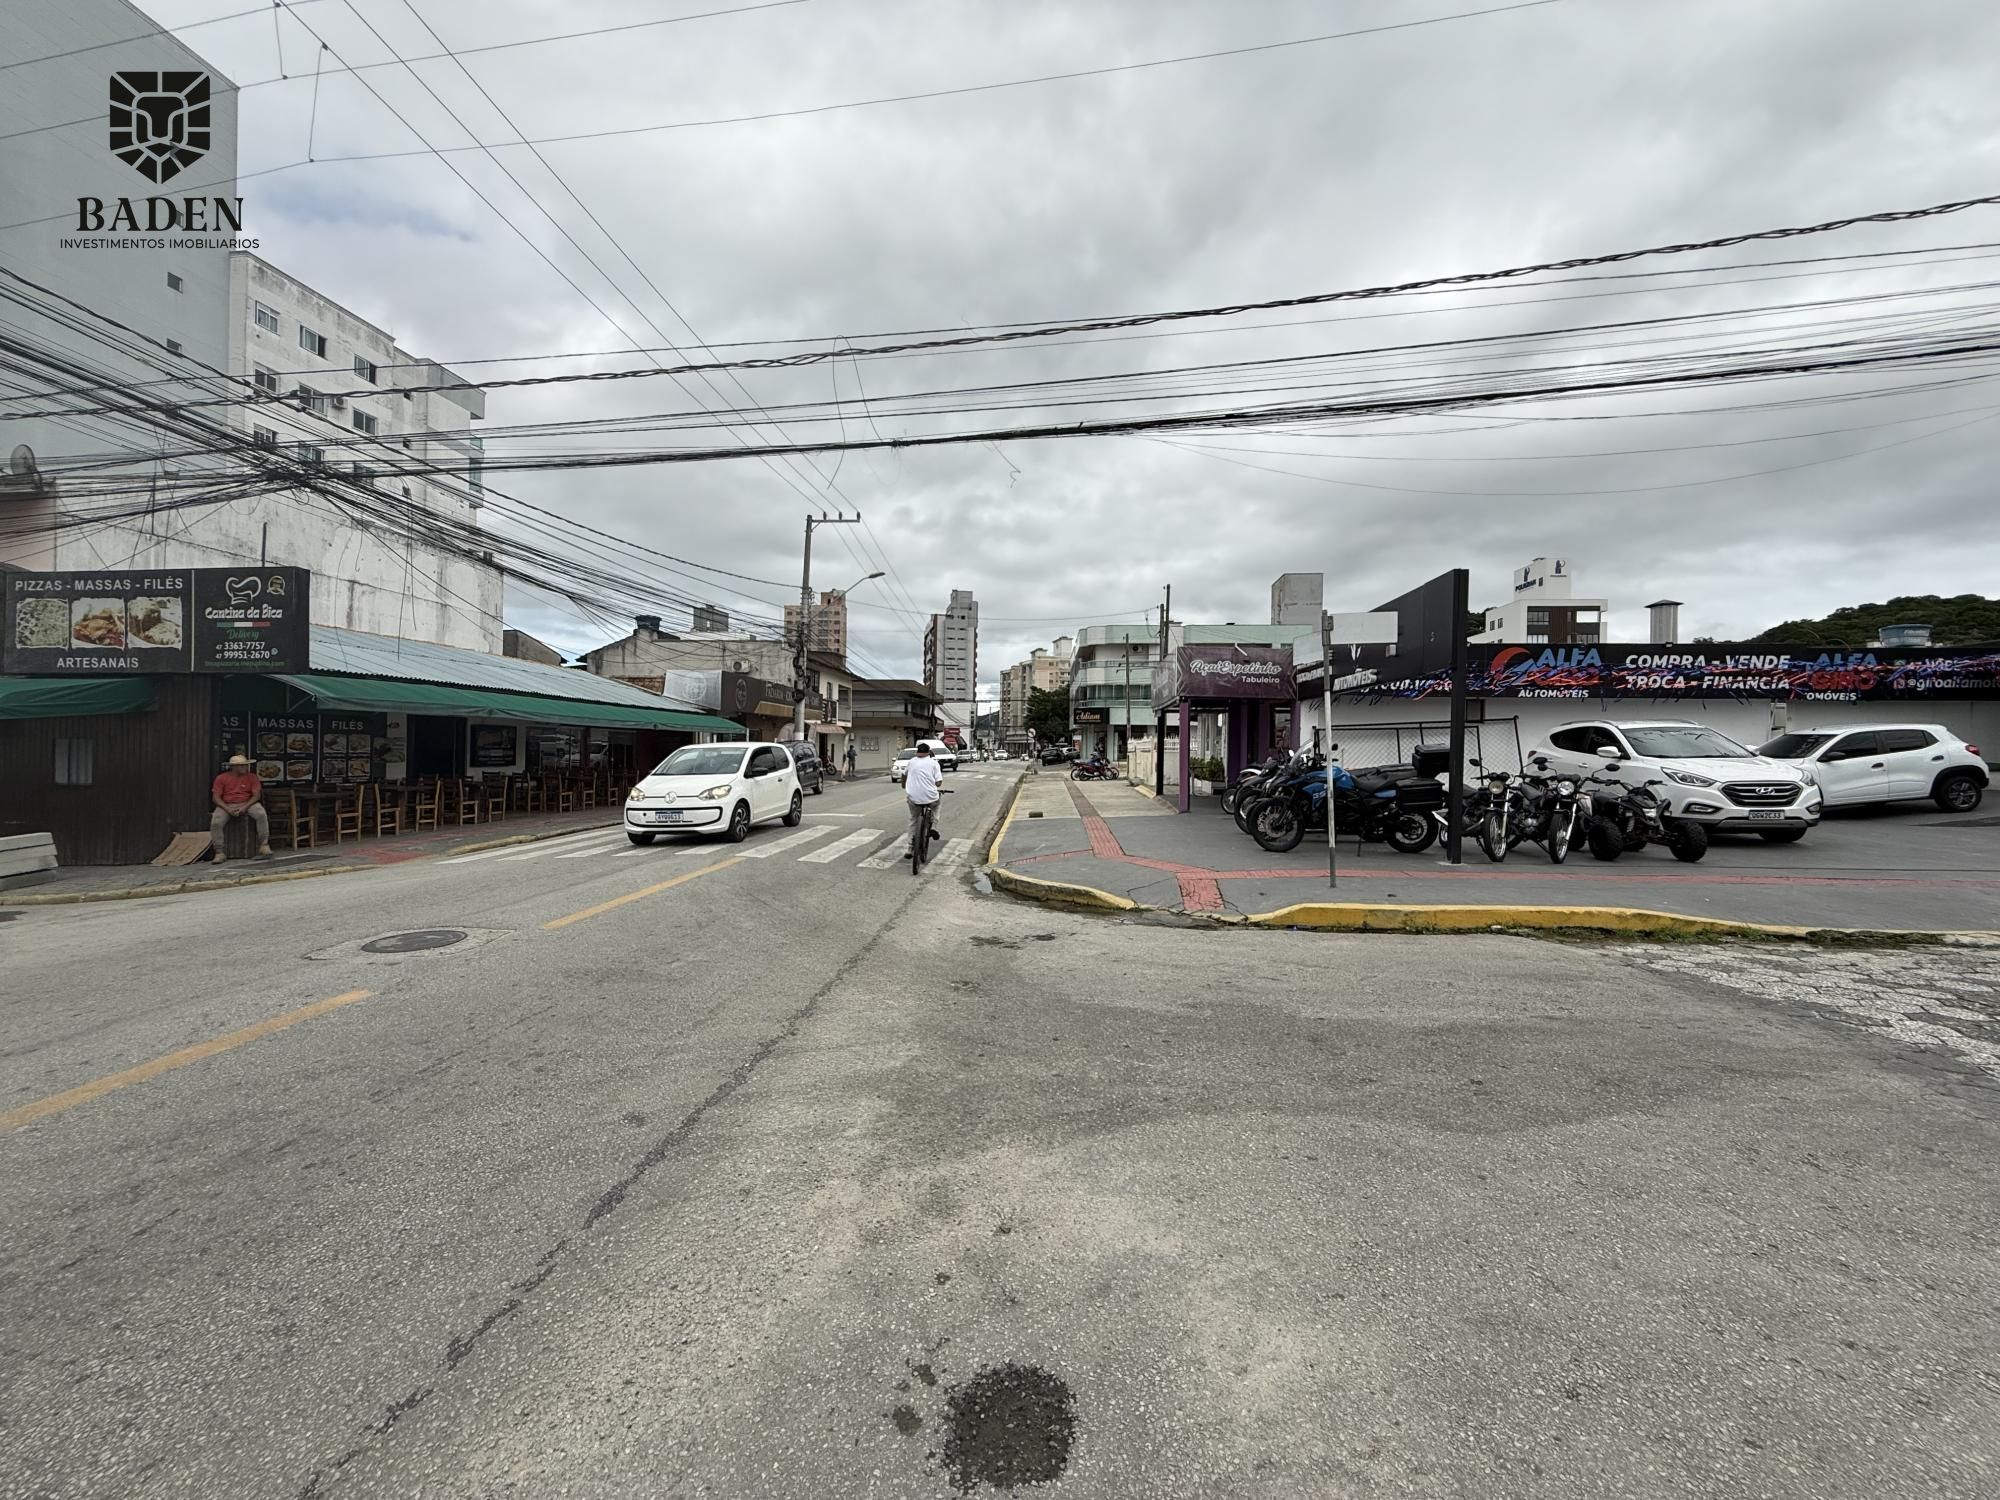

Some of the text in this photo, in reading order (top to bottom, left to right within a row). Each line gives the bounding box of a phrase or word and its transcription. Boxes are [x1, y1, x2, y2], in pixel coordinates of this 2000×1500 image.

[15, 579, 63, 591] PIZZAS
[74, 579, 132, 591] MASSAS
[143, 575, 184, 590] FILÉS
[204, 603, 283, 619] Cantina da Bica
[223, 641, 266, 650] 3363-7757
[223, 651, 270, 659] 99951-2670
[1537, 648, 1601, 667] ALFA
[1815, 653, 1878, 669] ALFA
[57, 657, 139, 669] ARTESANAIS
[1626, 654, 1706, 669] COMPRA
[1725, 655, 1792, 669] VENDE
[1625, 676, 1686, 689] TROCA
[1702, 676, 1790, 690] FINANCIA
[1518, 686, 1590, 698] AUTOMÓVEIS
[1804, 689, 1857, 700] OMÓVEIS
[257, 717, 315, 729] MASSAS
[331, 719, 364, 731] FILÉS
